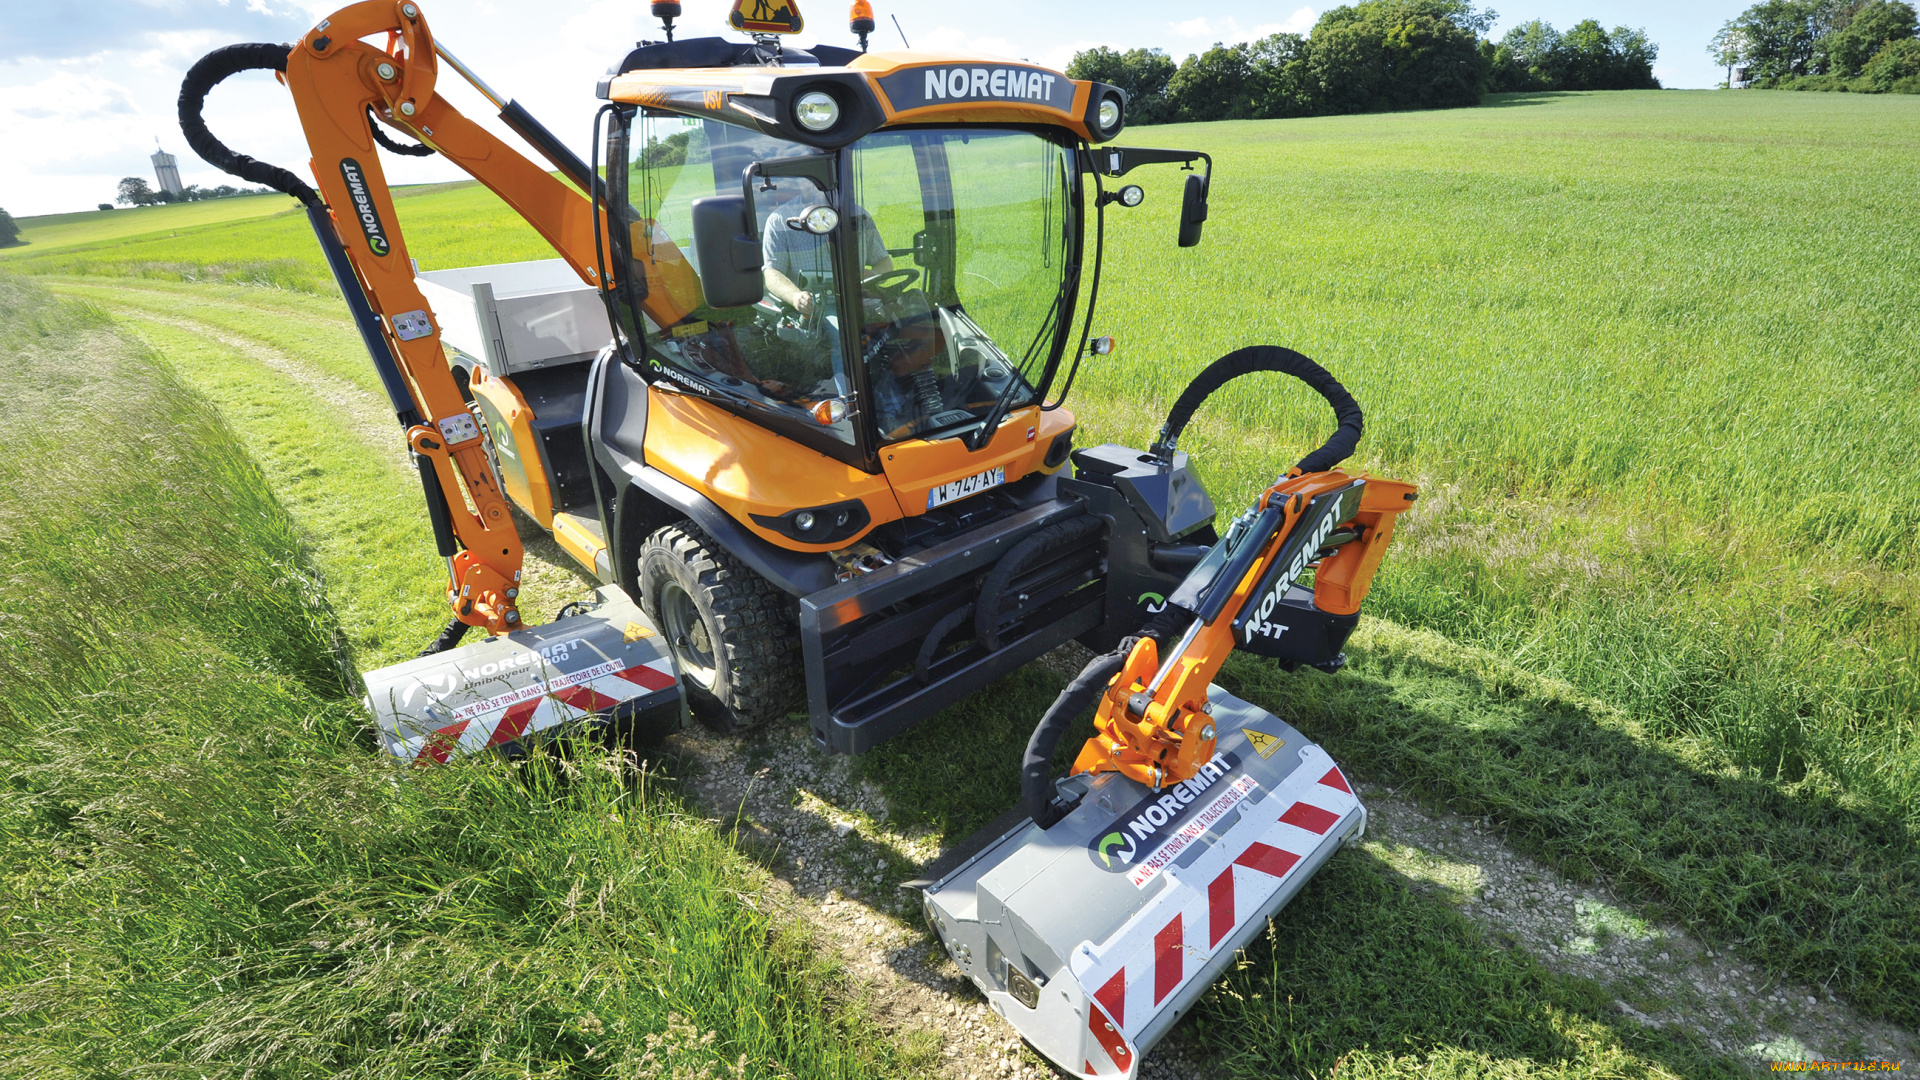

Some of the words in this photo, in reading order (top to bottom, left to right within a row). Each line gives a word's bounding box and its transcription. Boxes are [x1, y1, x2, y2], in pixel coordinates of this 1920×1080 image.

[925, 68, 1055, 101] NOREMAT
[702, 90, 723, 110] VSV
[342, 163, 380, 233] NOREMAT
[663, 366, 711, 396] NOREMAT
[1245, 493, 1344, 645] NOREMAT
[463, 638, 580, 682] NOREMAT
[464, 666, 531, 691] Unibroyeur
[534, 652, 570, 669] 1000
[476, 702, 491, 713] PAS
[491, 698, 500, 708] SE
[500, 692, 521, 705] TENIR
[521, 685, 541, 698] DANS
[551, 672, 592, 689] TRAJECTOIRE
[591, 668, 601, 677] DE
[600, 661, 624, 674] L'OUTIL
[1128, 751, 1232, 841] NOREMAT
[1179, 824, 1200, 844] DANS
[1193, 818, 1207, 831] LA
[1158, 849, 1171, 862] SE
[1164, 837, 1186, 856] TENIR
[1139, 866, 1153, 879] NE
[1147, 856, 1164, 872] PAS
